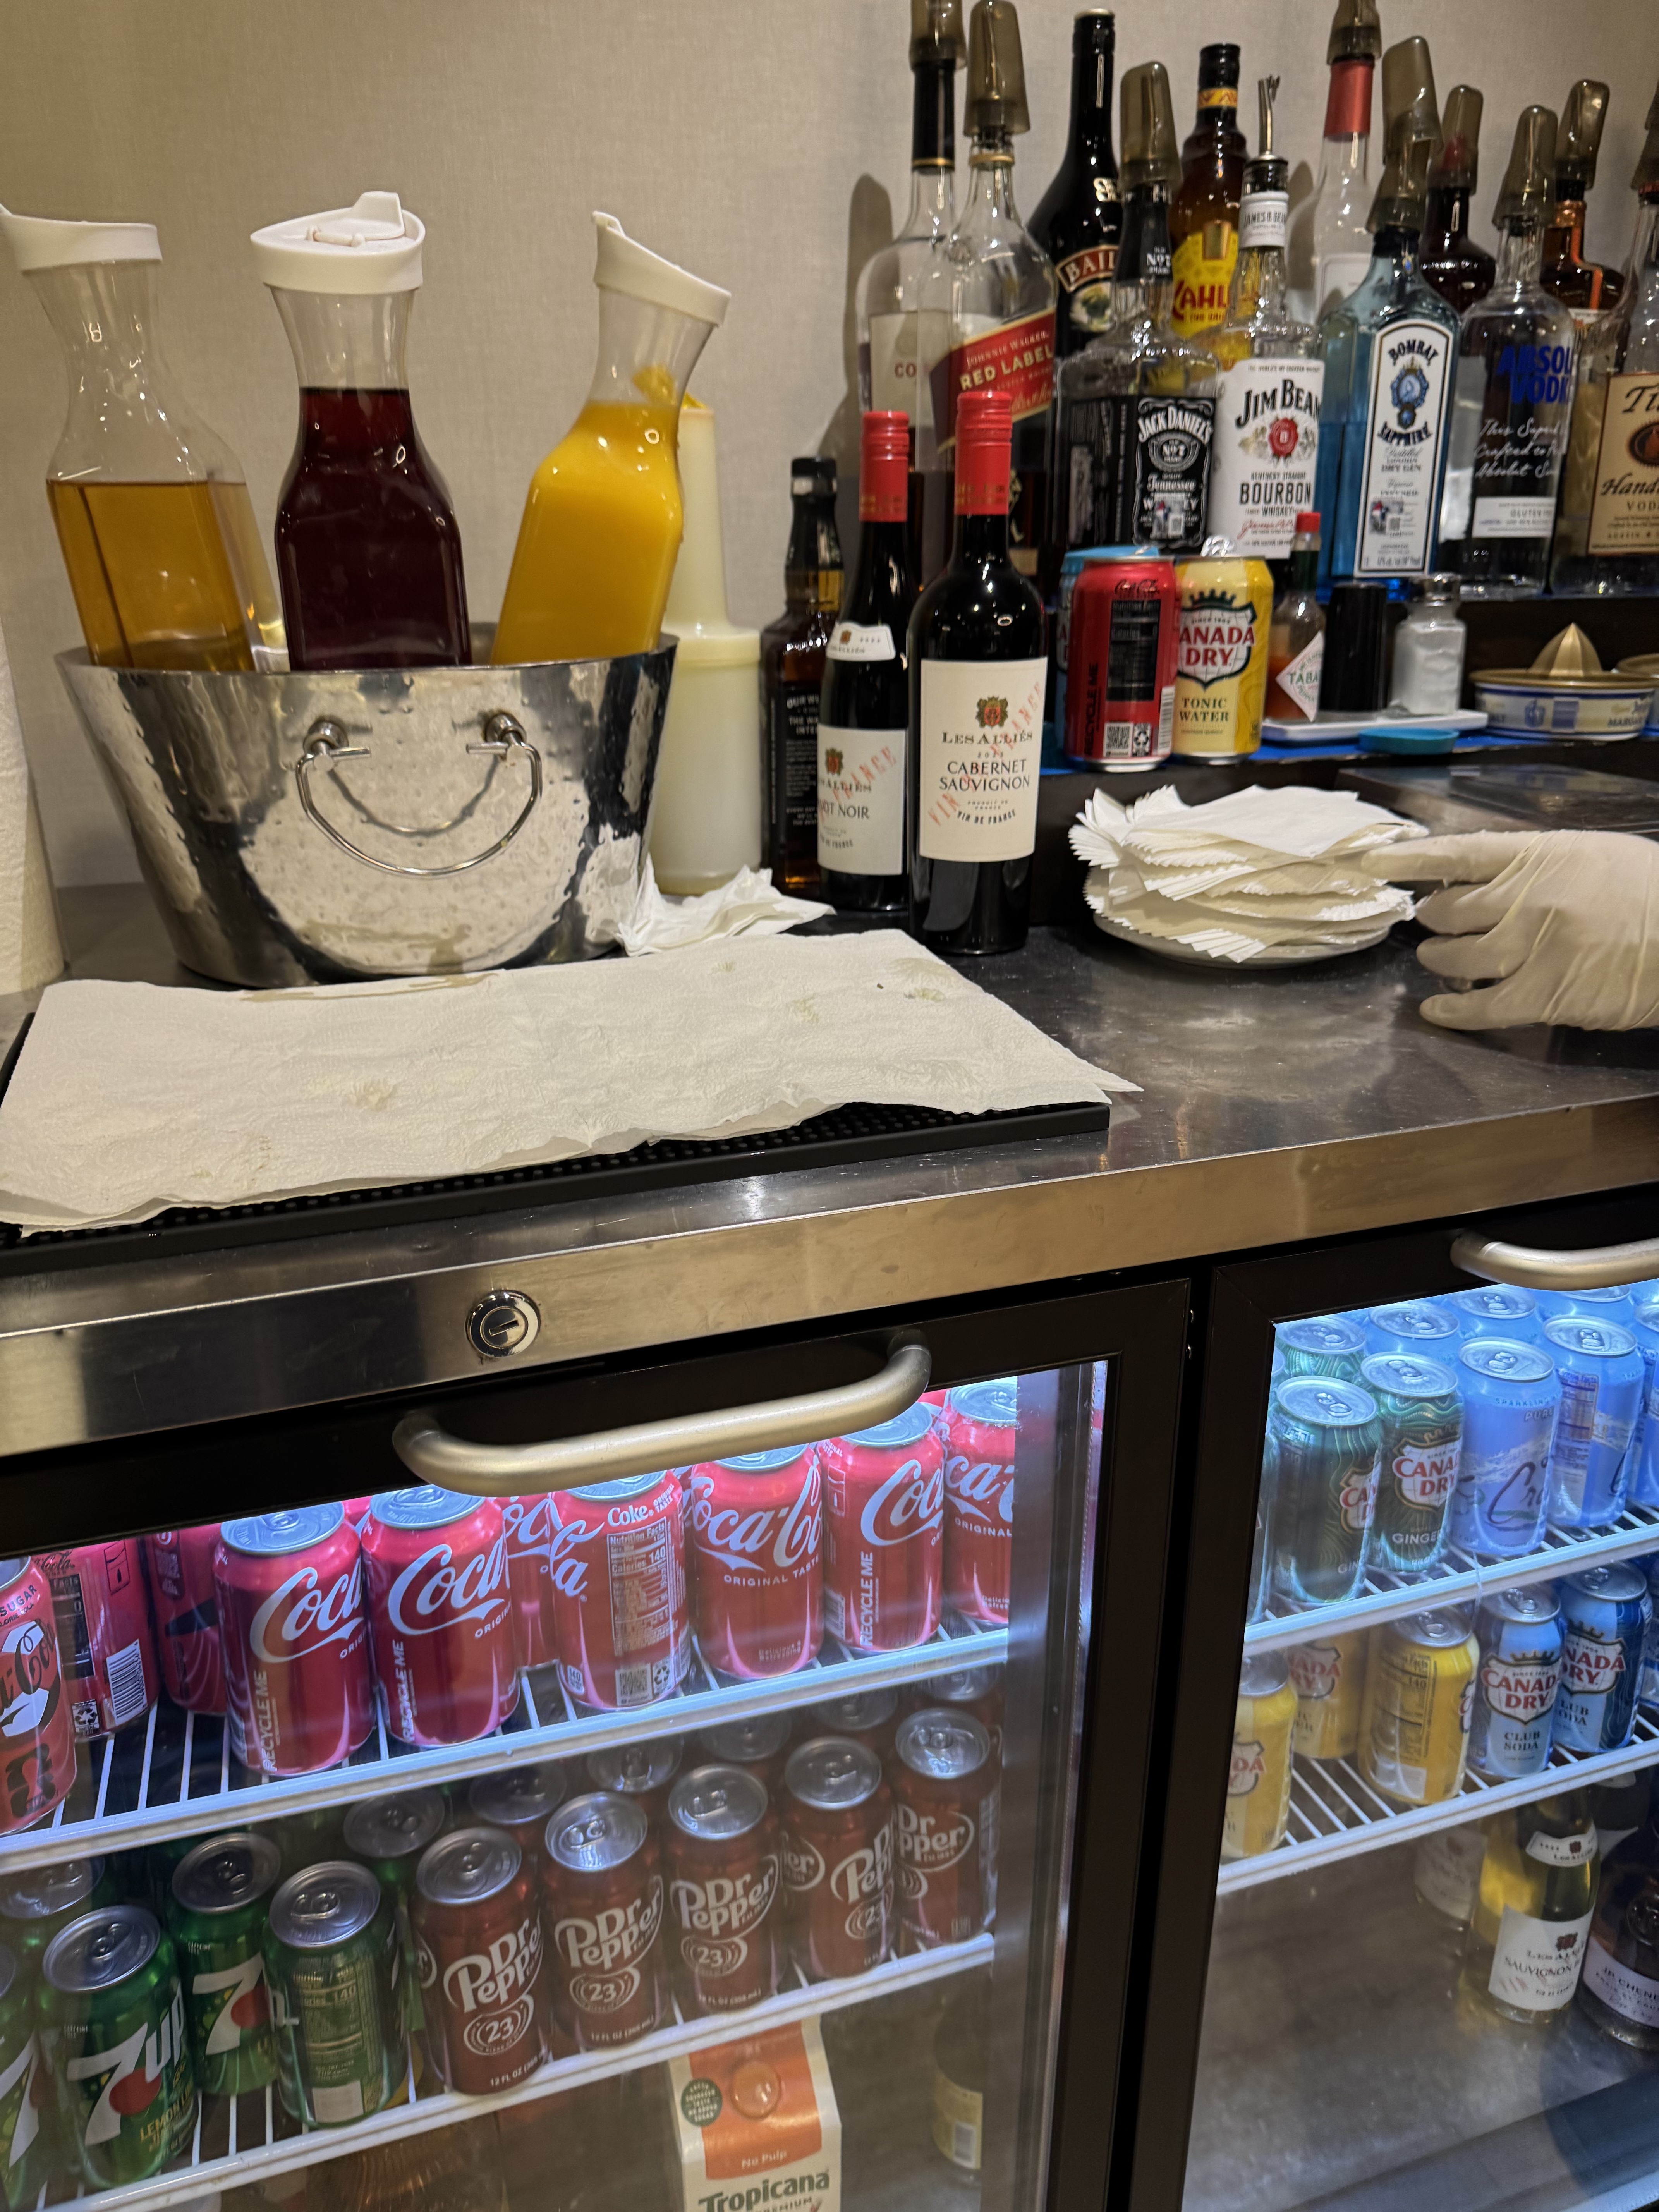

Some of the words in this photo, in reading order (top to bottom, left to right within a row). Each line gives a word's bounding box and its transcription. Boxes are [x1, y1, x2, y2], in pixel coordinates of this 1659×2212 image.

[1000, 343, 1053, 375] LABEL
[1388, 339, 1438, 366] BOMBAY
[1496, 344, 1570, 376] ABSOL
[960, 366, 996, 391] RED
[1510, 374, 1568, 404] VODK
[1235, 388, 1278, 429] JIM
[1138, 410, 1167, 443] JACK
[1168, 405, 1213, 445] DANIEL'S
[1377, 421, 1433, 446] SAPPHIRE
[1251, 472, 1280, 481] KENTUCKY
[1600, 472, 1659, 496] Hand
[1240, 482, 1312, 504] BOURBON
[1262, 505, 1292, 517] WHISKEY
[1180, 627, 1254, 645] ANADA
[1185, 647, 1233, 666] DRY
[1288, 671, 1321, 686] TABA
[1182, 697, 1227, 708] TONIC
[1180, 710, 1228, 722] WATER
[796, 726, 817, 735] INTE
[942, 732, 974, 744] LES
[977, 730, 1033, 745] ALLIÉS
[947, 759, 1027, 776] CABERNET
[939, 775, 1030, 792] SAUVIGNON
[838, 804, 869, 819] NOIR
[957, 811, 971, 823] VIN
[974, 816, 984, 825] DE
[988, 809, 1016, 825] FRANCE
[653, 1483, 675, 1506] ORIGINAL
[655, 1496, 673, 1513] TASTE
[608, 1505, 649, 1527] Coke
[955, 1516, 1012, 1538] ORIGINAL
[610, 1532, 645, 1545] Nutrition
[646, 1522, 665, 1536] Facts
[1392, 1530, 1444, 1544] GINGE
[649, 1546, 666, 1563] 140
[860, 1551, 873, 1576] ME
[611, 1560, 647, 1573] Calories
[723, 1574, 788, 1587] ORIGINAL
[0, 1584, 38, 1618] SUGAR
[860, 1578, 873, 1647] RECYCLE
[474, 1603, 512, 1639] ORIGIN
[392, 1639, 406, 1666] ME
[1566, 1647, 1625, 1671] NADA
[254, 1669, 268, 1697] ME
[1482, 1668, 1556, 1692] CANAD
[394, 1668, 415, 1742] RECYCLE
[1505, 1694, 1549, 1710] DRY
[1561, 1699, 1589, 1716] LUB
[1559, 1710, 1587, 1725] ODA
[256, 1698, 277, 1772] RECYCLE
[1504, 1730, 1540, 1741] CLUB
[1504, 1741, 1539, 1750] SODA
[897, 1803, 935, 1835] Dr
[899, 1826, 965, 1861] pper
[670, 1865, 775, 1937] Pepper
[705, 1873, 752, 1909] Dr
[555, 1887, 661, 1971] Pepper
[595, 1898, 642, 1941] Dr
[489, 1918, 530, 1975] Dr
[697, 1946, 723, 1968] 23
[589, 1982, 617, 2002] 23
[486, 2016, 514, 2044] 23
[490, 2075, 499, 2087] 12
[501, 2072, 511, 2084] FL
[512, 2068, 522, 2079] OZ
[140, 2100, 180, 2142] LEMON
[741, 2157, 759, 2169] No
[761, 2148, 787, 2164] Pulp
[698, 2171, 830, 2212] Tropicana
